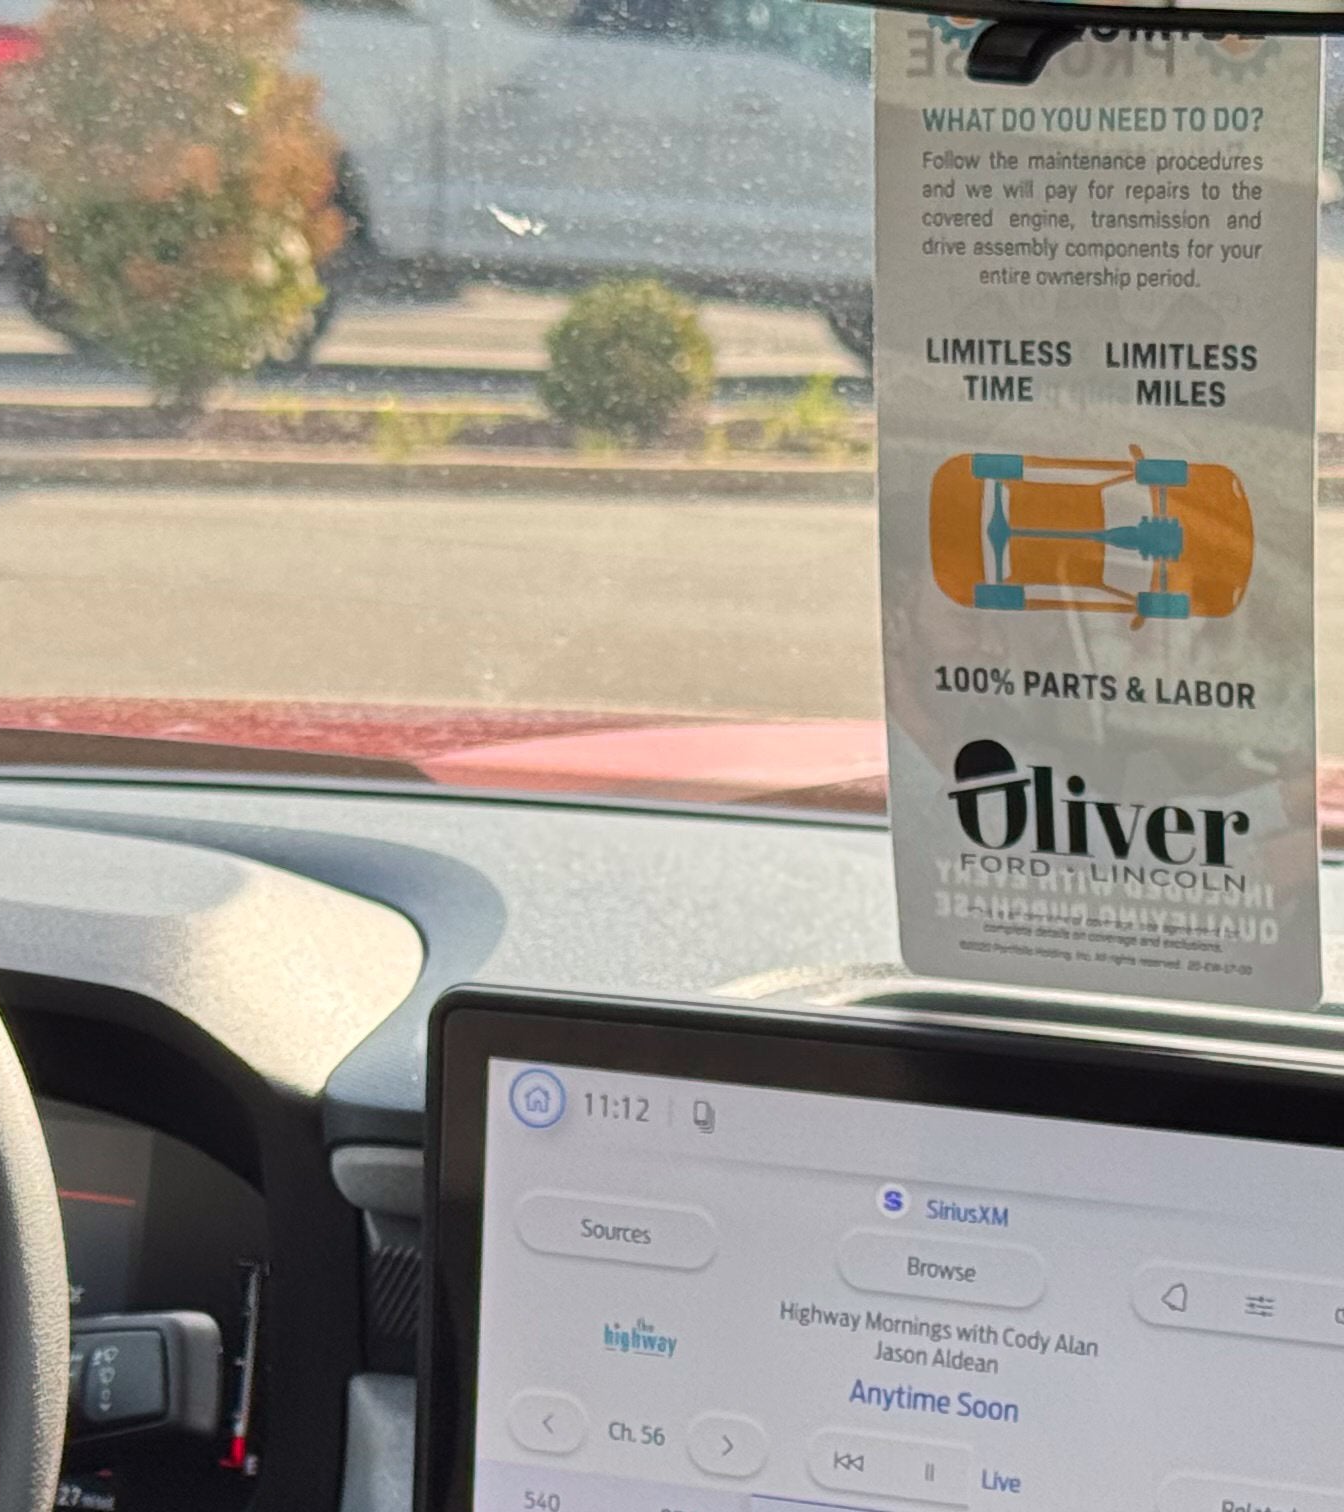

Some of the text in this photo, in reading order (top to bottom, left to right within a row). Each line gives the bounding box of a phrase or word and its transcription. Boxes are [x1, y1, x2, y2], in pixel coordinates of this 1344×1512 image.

[922, 107, 1264, 132] WHAT DO YOU NEED TO DO?
[922, 151, 1263, 176] Follow the maintenance procedures
[922, 181, 1262, 205] and we will pay for repairs to the
[922, 210, 1262, 235] covered engine, transmission and
[922, 238, 1262, 264] drive assembly components for your
[979, 267, 1200, 292] entire ownership period.
[926, 338, 1072, 368] LIMITLESS
[1106, 342, 1258, 371] LIMITLESS
[963, 375, 1034, 402] TIME
[1136, 380, 1226, 407] MILES
[935, 666, 1257, 710] 100% PARTS & LABOR
[948, 739, 1251, 868] Oliver
[961, 853, 1247, 893] FORD LINCOLN
[584, 1092, 650, 1122] 11:12
[926, 1199, 1009, 1227] SiriusXM
[581, 1218, 652, 1245] Sources
[907, 1256, 977, 1283] Browse
[603, 1322, 678, 1358] highway
[780, 1300, 1099, 1358] Highway Mornings with Cody Alan
[875, 1340, 999, 1374] Jason Aldean
[849, 1378, 1020, 1423] Anytime Soon
[608, 1422, 666, 1446] Ch. 56
[981, 1468, 1022, 1494] Live
[523, 1491, 561, 1512] 540
